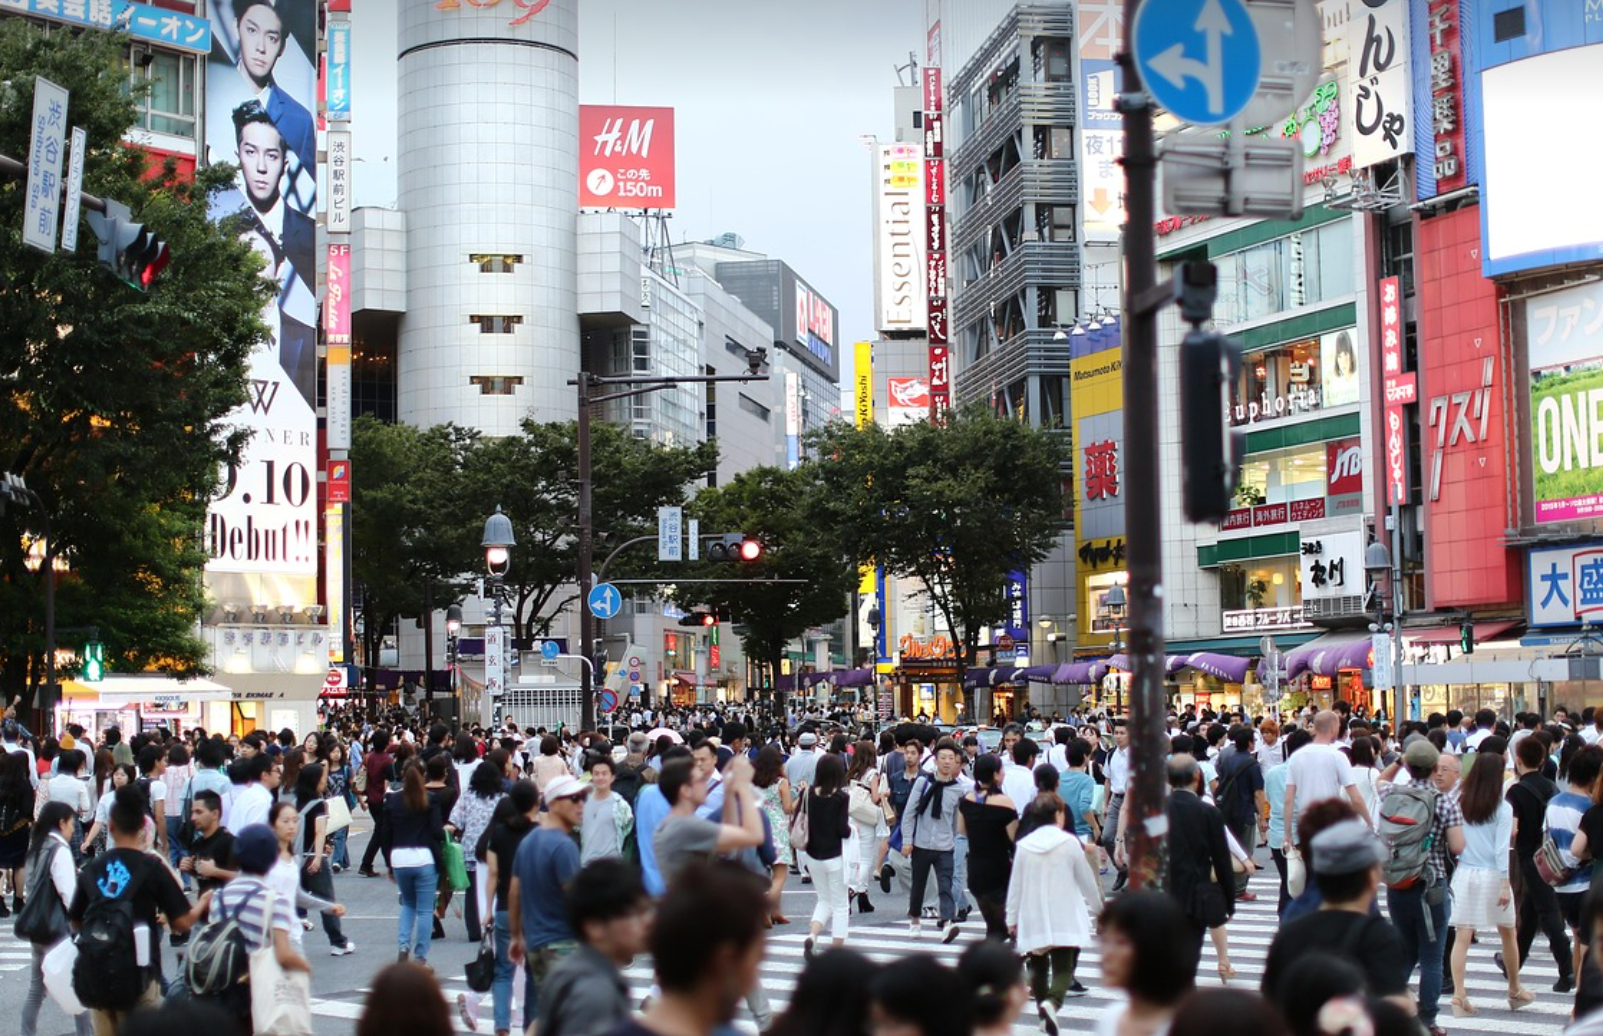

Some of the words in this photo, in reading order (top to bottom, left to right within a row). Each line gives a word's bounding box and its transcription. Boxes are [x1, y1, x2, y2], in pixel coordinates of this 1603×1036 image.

[1356, 0, 1405, 150] んじゃ
[1428, 0, 1458, 180] 千里薬品
[33, 115, 45, 176] Shibuya
[594, 118, 654, 158] H&M
[333, 141, 345, 223] 渋谷駅前ビル
[617, 169, 650, 180] この先
[617, 182, 662, 197] 150m
[329, 245, 349, 256] 5F
[884, 192, 913, 325] Essential
[1074, 365, 1110, 381] Matsumoto
[1330, 446, 1362, 484] JTB
[668, 511, 679, 556] 渋谷駅前
